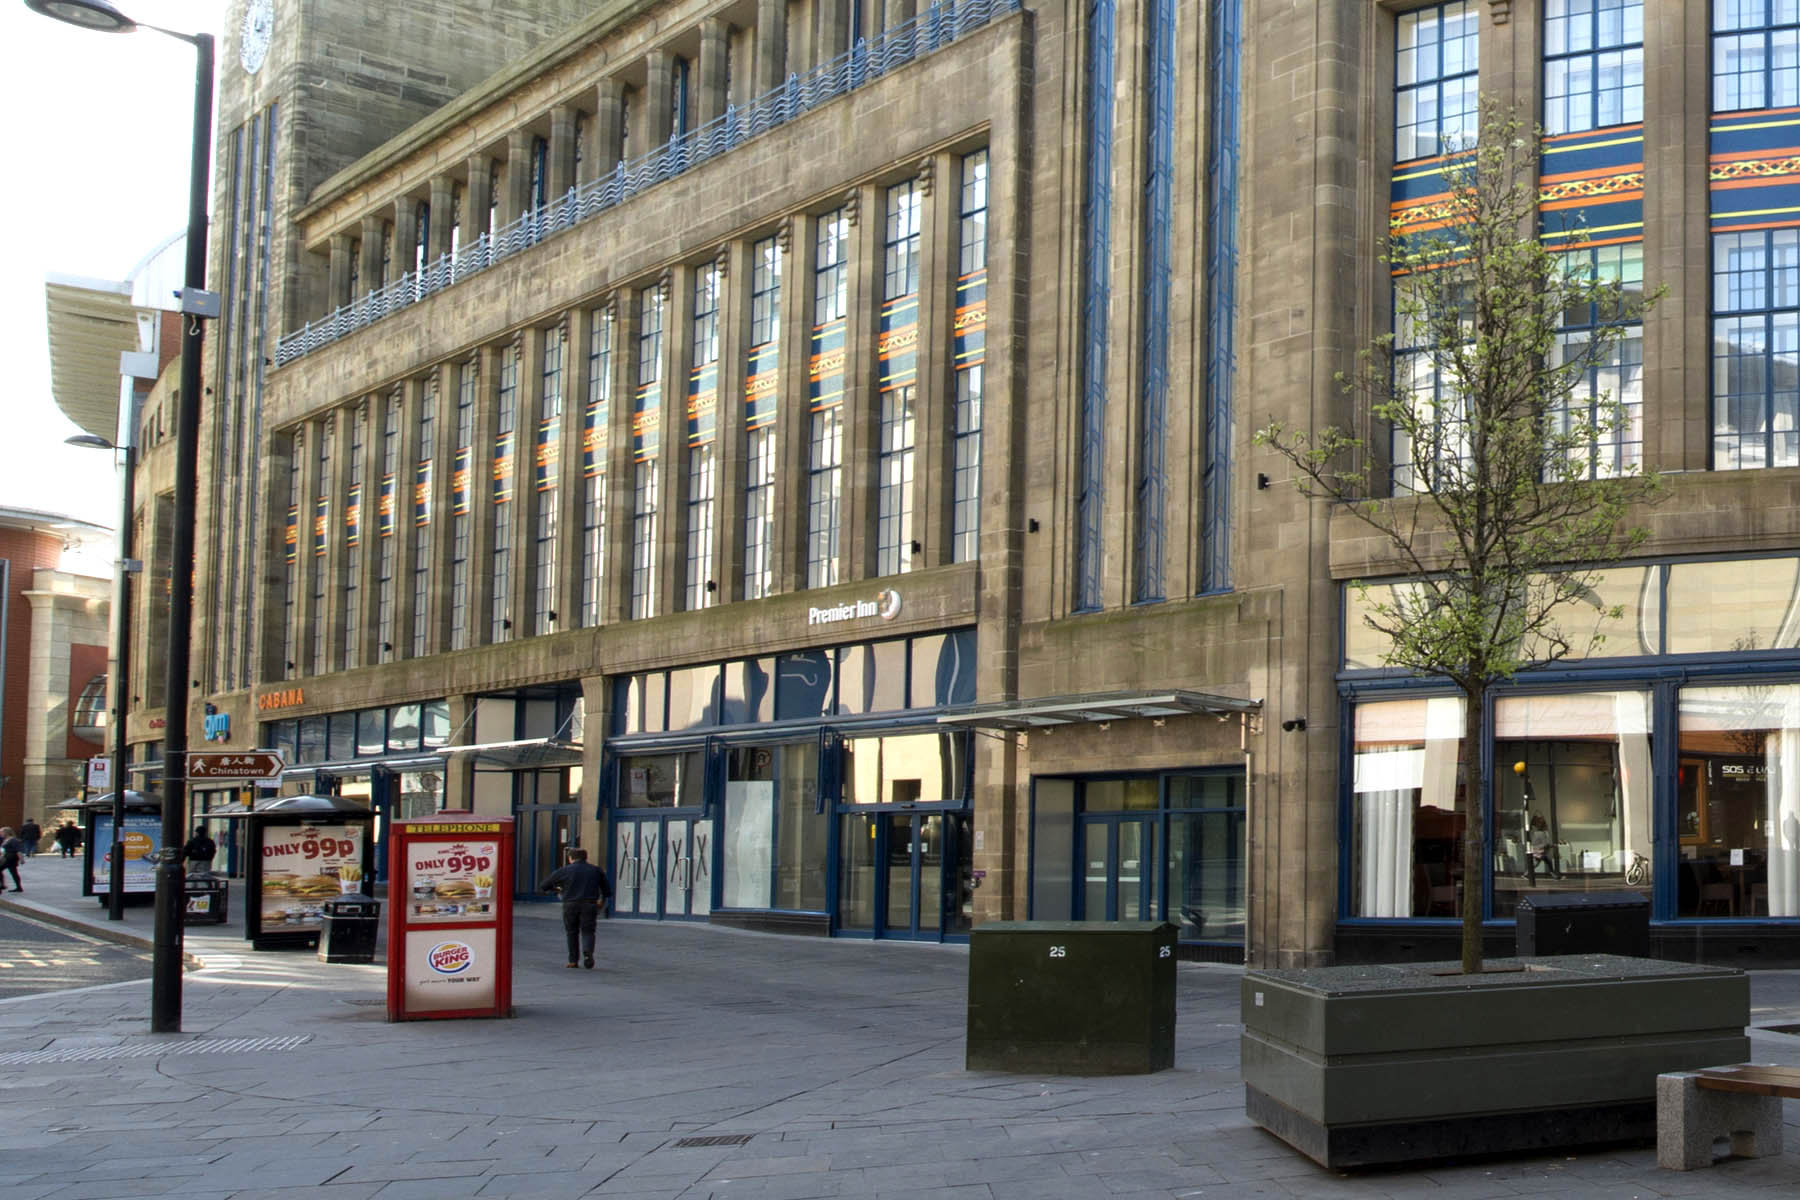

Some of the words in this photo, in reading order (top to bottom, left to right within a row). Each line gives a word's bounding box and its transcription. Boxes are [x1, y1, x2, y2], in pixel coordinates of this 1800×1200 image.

[808, 602, 856, 625] Premier
[856, 600, 878, 619] Inn
[259, 687, 304, 710] CABANA
[204, 712, 230, 741] gym
[209, 766, 265, 775] Chinatown
[414, 823, 493, 833] TELEPHONE
[263, 843, 300, 857] ONLY
[302, 838, 354, 860] 99p
[415, 859, 446, 871] ONLY
[447, 855, 491, 873] 99p
[433, 946, 468, 960] BURGER
[1049, 946, 1066, 957] 25
[1159, 946, 1171, 958] 25
[434, 952, 470, 969] KING
